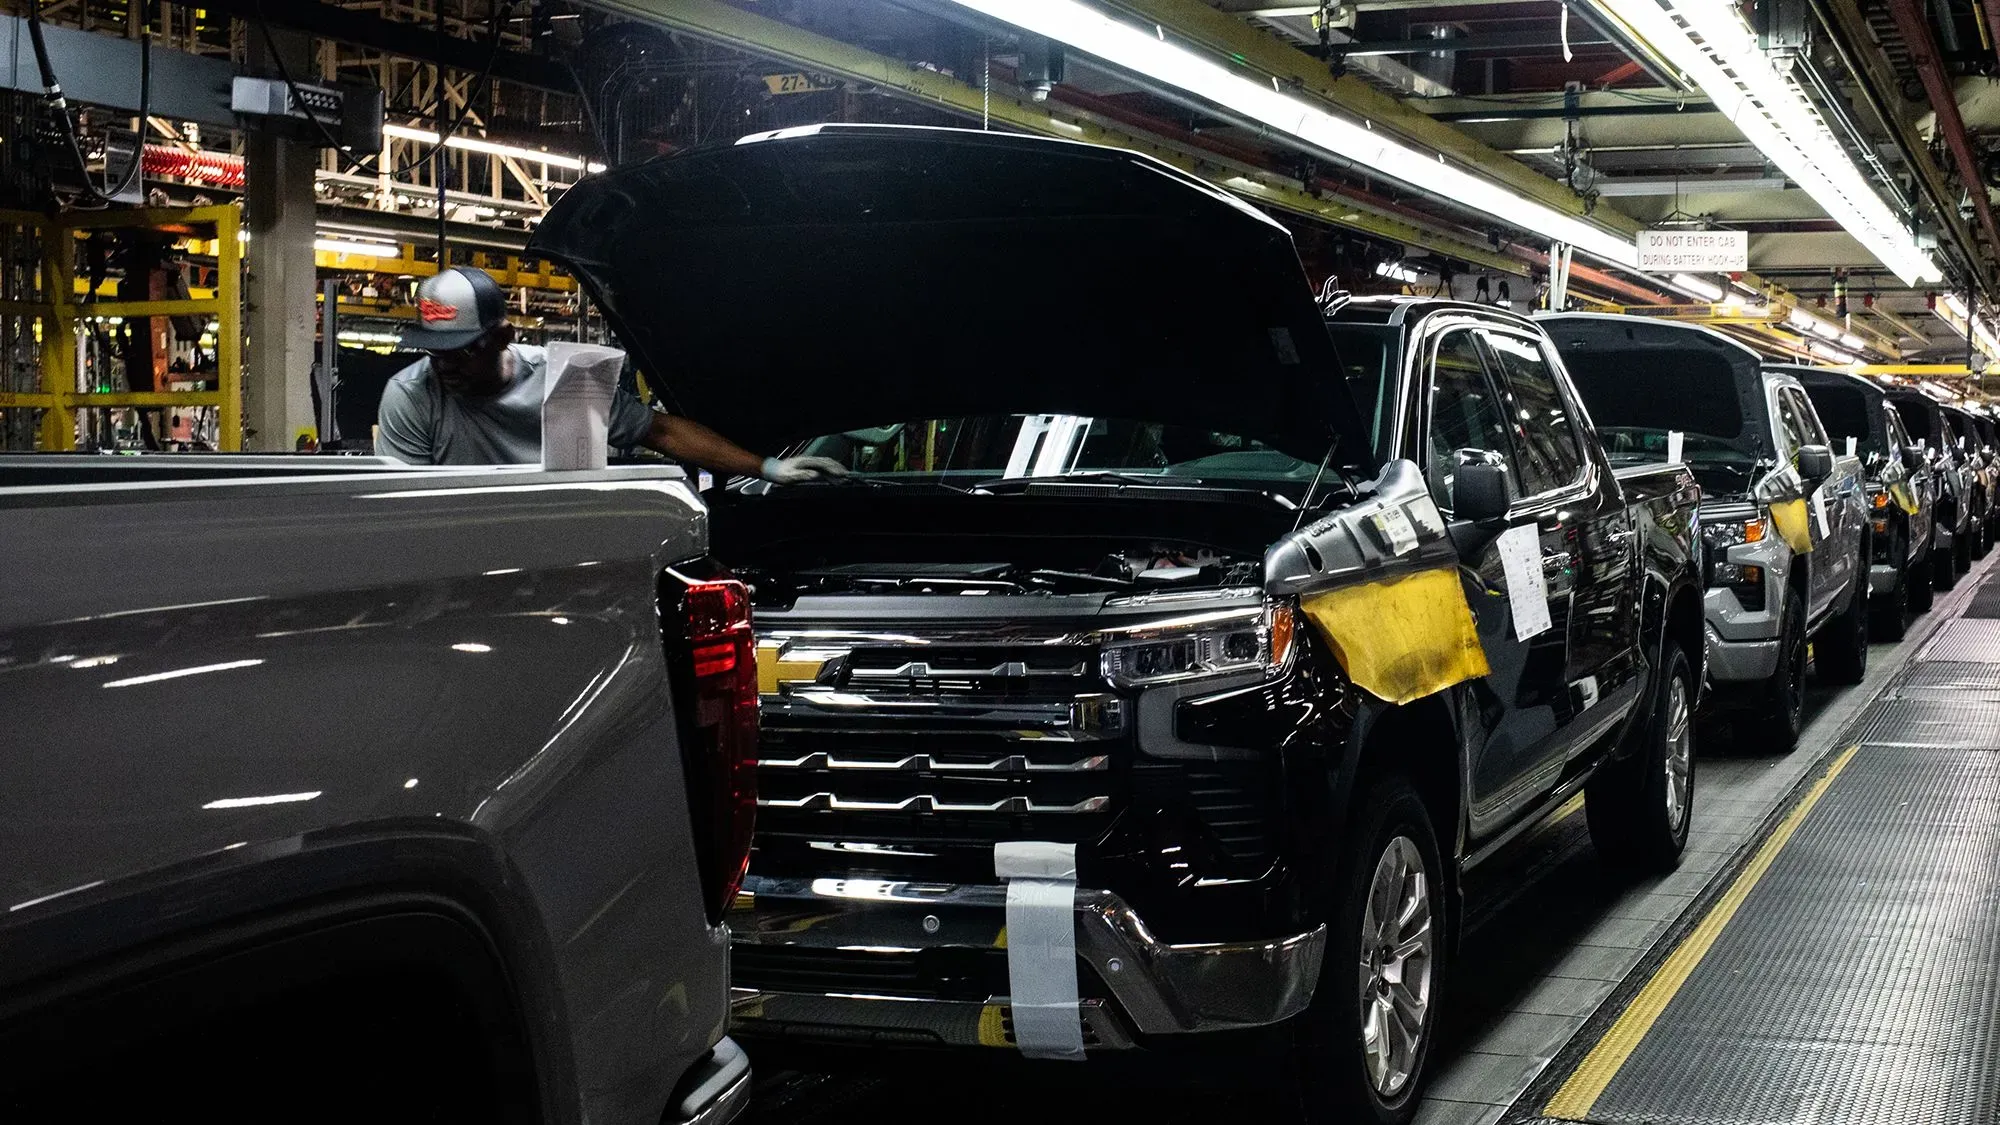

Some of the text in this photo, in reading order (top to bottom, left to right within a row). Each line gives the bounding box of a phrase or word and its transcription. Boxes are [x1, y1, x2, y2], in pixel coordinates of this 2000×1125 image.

[1650, 235, 1736, 247] DO NOT ENTER CAB
[1643, 254, 1745, 266] DURING BATTERY HOOK-UP
